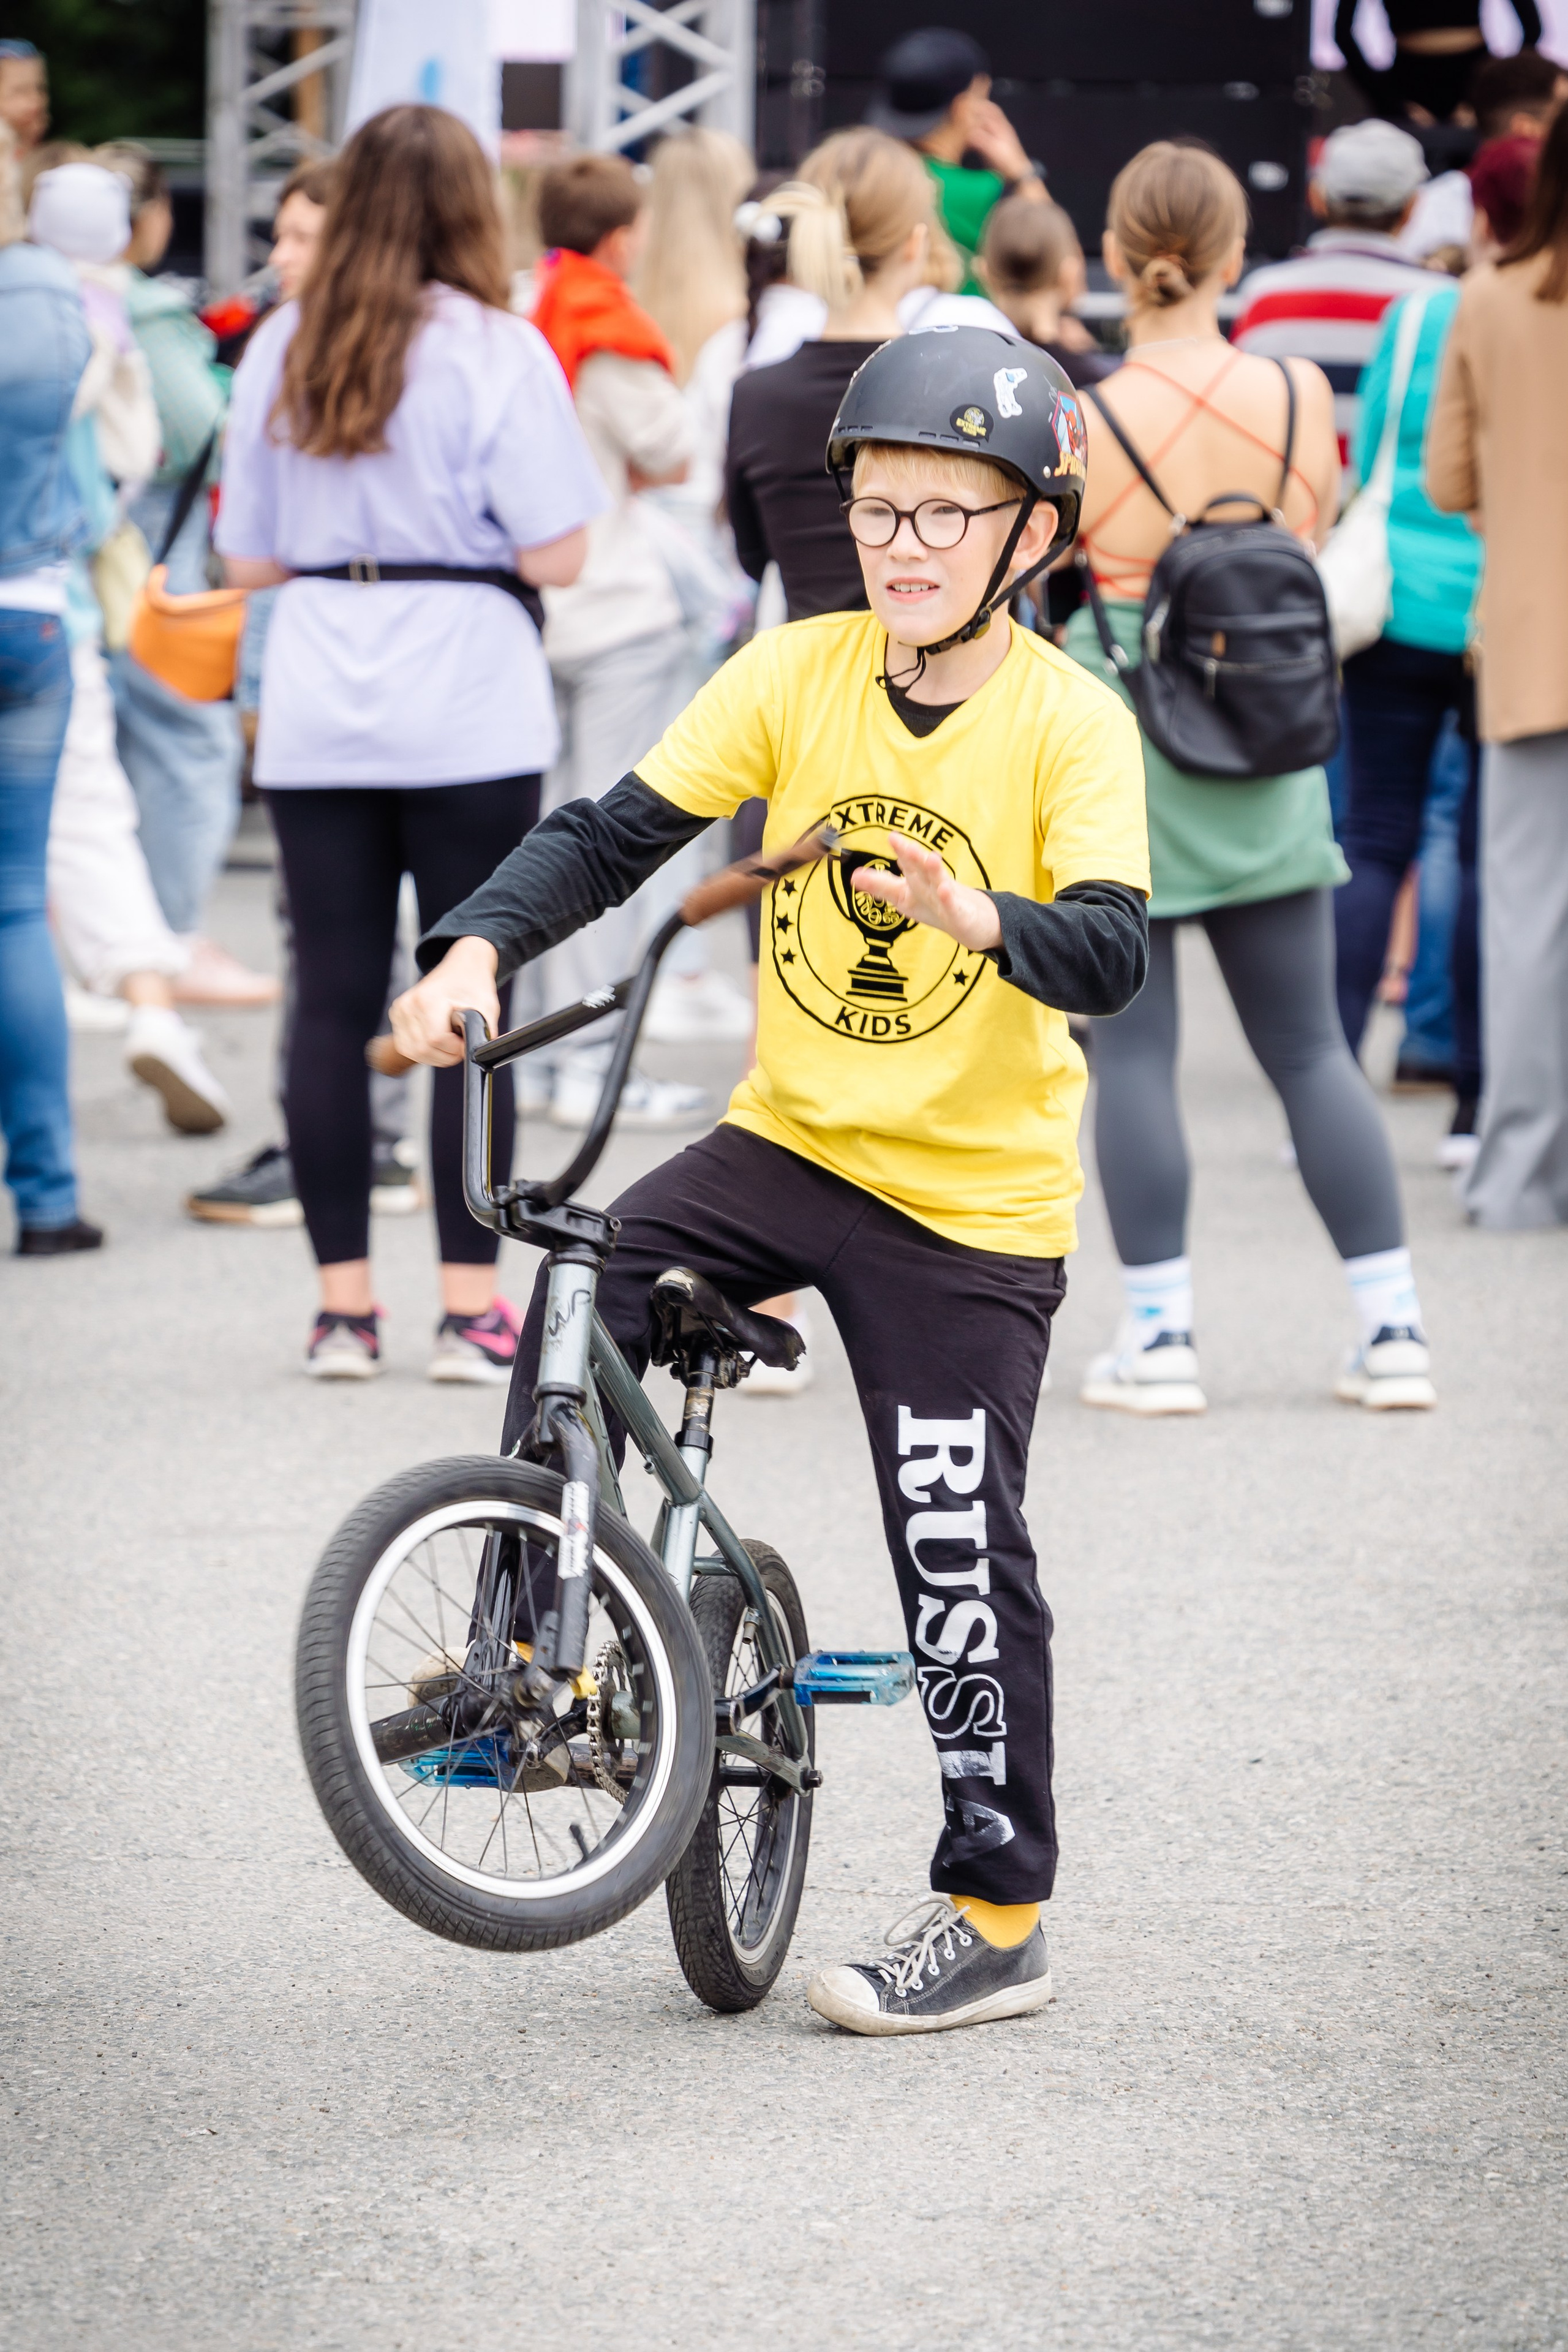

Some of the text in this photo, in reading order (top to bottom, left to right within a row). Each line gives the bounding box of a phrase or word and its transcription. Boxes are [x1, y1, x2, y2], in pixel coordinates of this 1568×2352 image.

[834, 801, 954, 851] XTREME
[834, 1006, 912, 1036] KIDS
[898, 1405, 1016, 1868] RUSSIA
